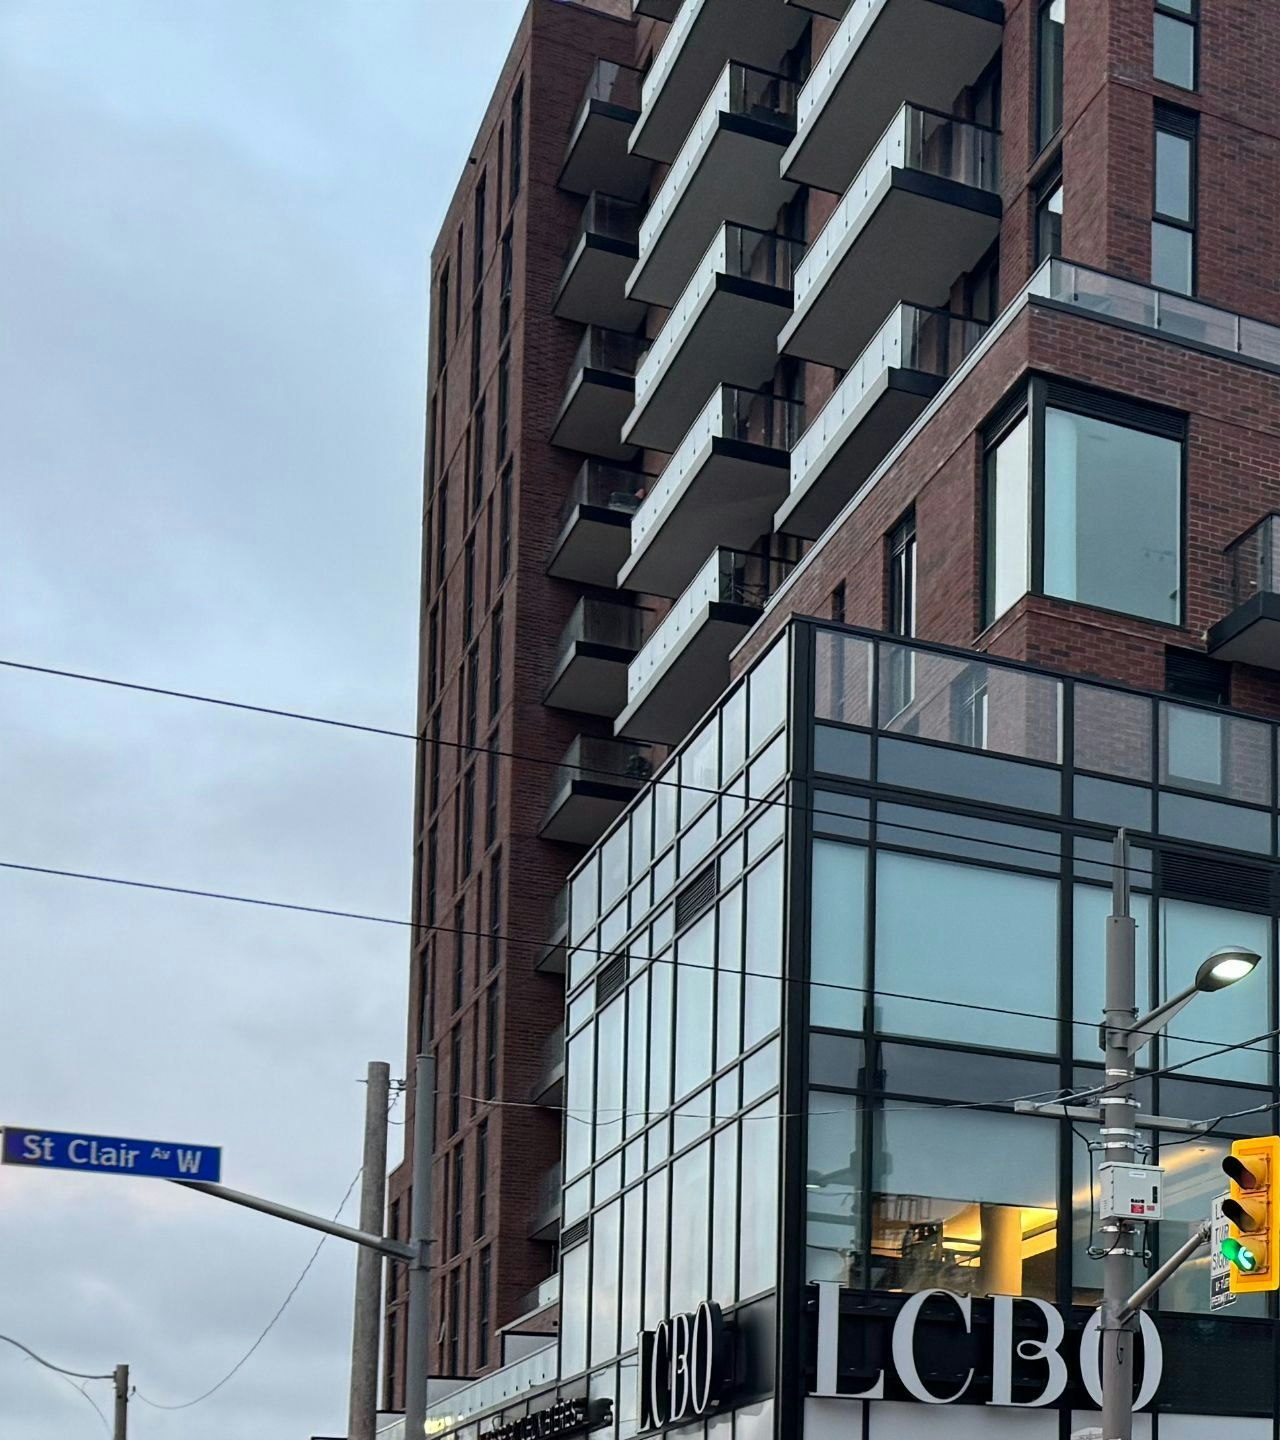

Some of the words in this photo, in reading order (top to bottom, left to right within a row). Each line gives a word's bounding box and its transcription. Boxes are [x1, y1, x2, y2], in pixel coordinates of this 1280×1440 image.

[23, 1135, 54, 1160] St
[67, 1139, 140, 1168] Clair
[177, 1149, 202, 1174] W
[636, 1301, 716, 1434] LCBO
[808, 1279, 1163, 1413] LCBO
